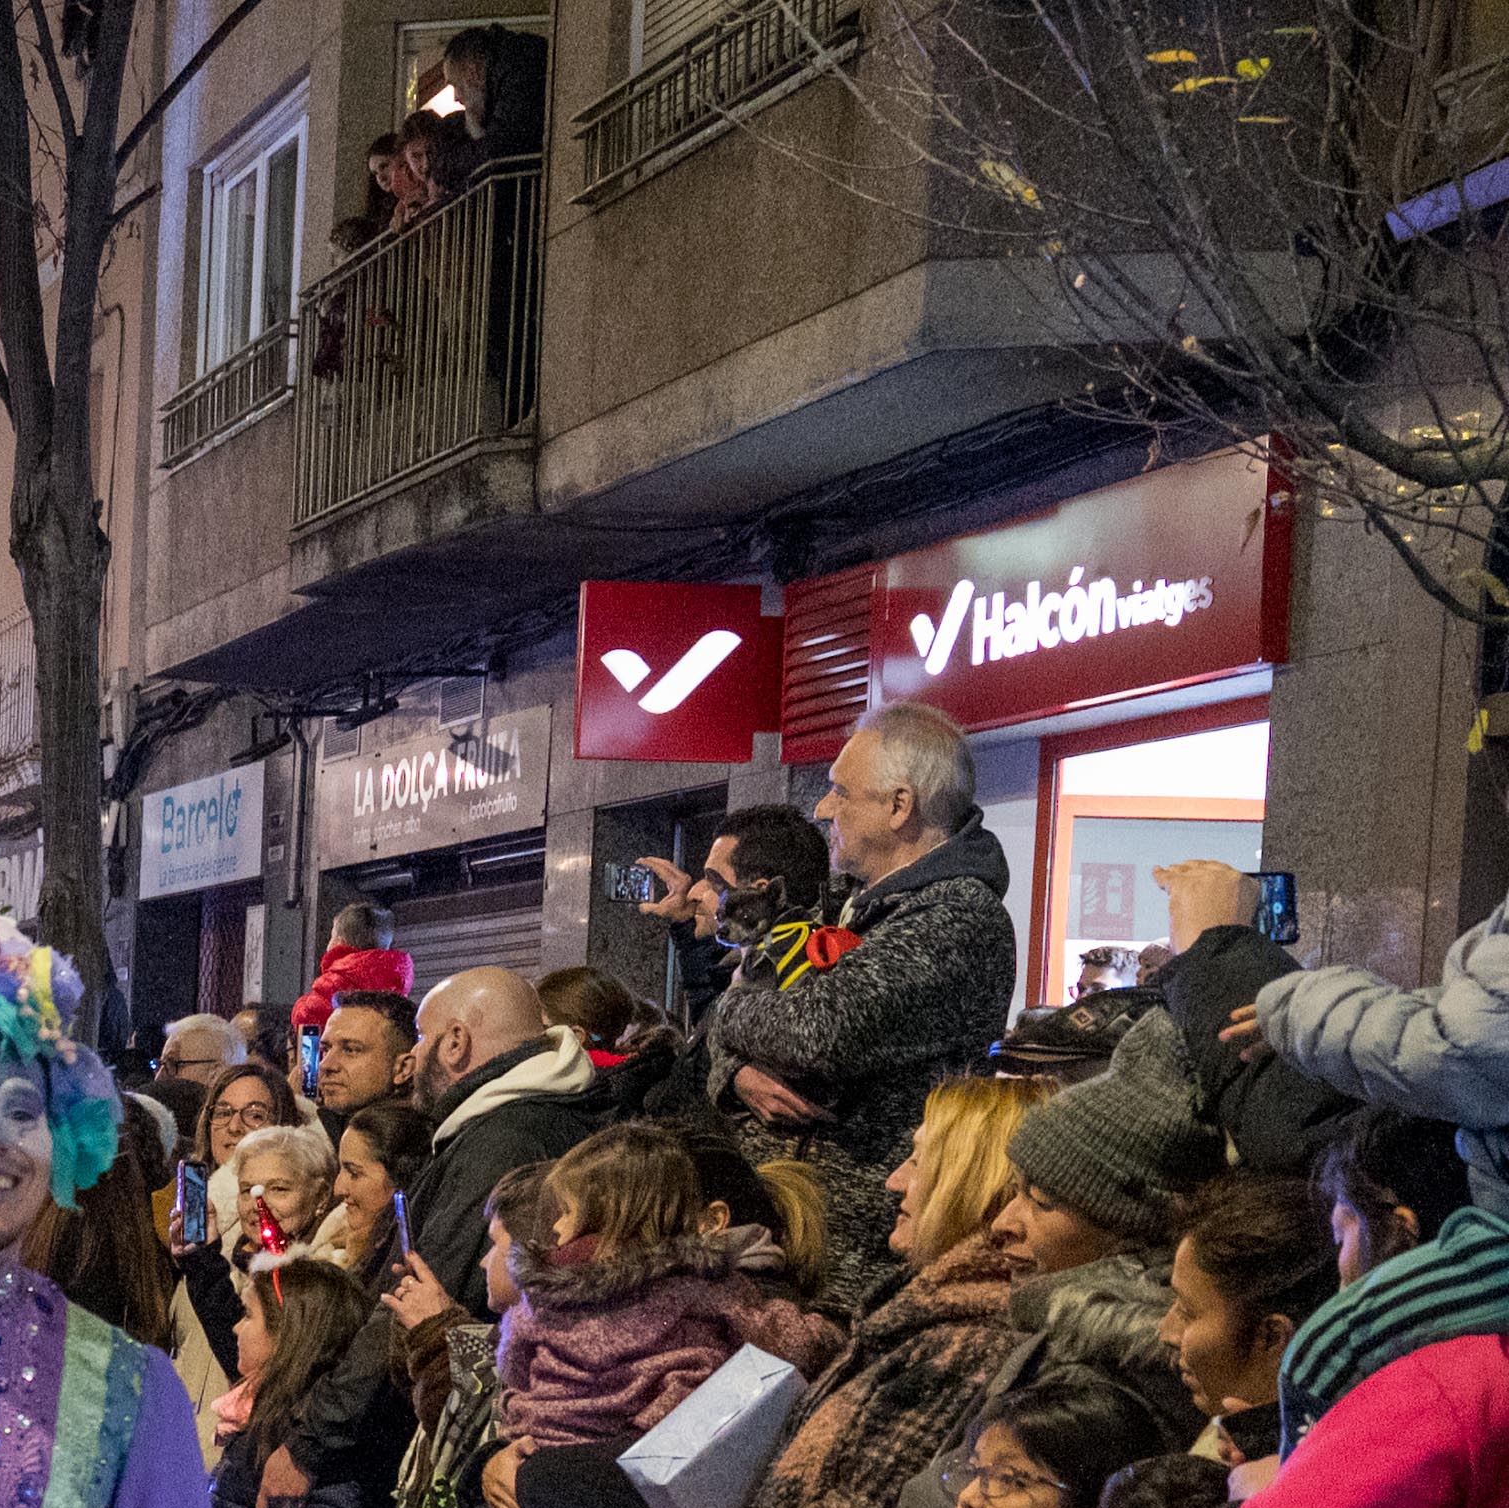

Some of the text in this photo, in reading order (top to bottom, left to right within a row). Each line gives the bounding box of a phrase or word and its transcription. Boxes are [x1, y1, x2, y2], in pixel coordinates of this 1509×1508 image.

[971, 566, 1214, 666] Halcón viatges
[354, 728, 521, 818] LA DOLÇA FRUITA
